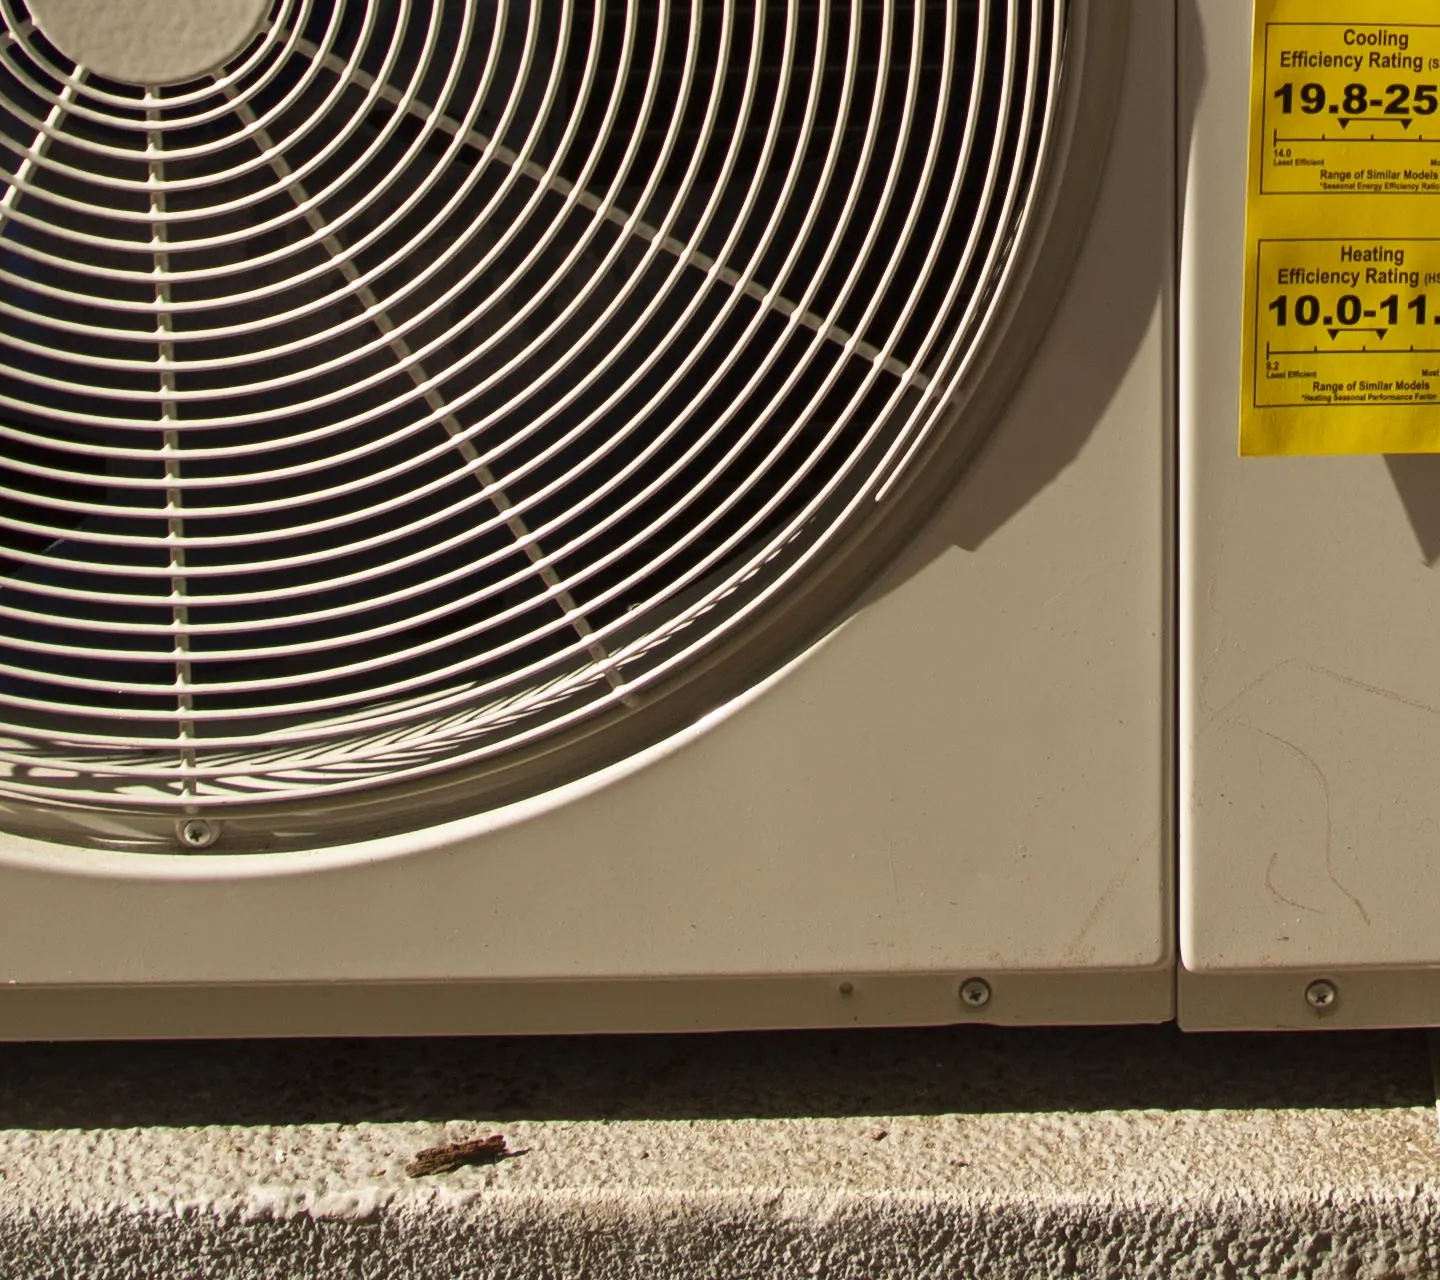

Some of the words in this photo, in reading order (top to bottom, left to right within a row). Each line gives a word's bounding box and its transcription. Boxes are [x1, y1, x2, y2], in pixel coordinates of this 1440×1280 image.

[1343, 29, 1409, 49] Cooling
[1280, 51, 1363, 71] Efficiency
[1369, 52, 1423, 72] Rating
[1273, 149, 1291, 158] 14.0
[1320, 170, 1351, 181] Range
[1354, 170, 1364, 180] of
[1366, 170, 1400, 180] Similar
[1404, 170, 1438, 180] Models
[1357, 182, 1382, 190] Energy
[1385, 182, 1419, 190] Efficiency
[1422, 182, 1440, 190] Ratio
[1341, 246, 1404, 265] Heating
[1278, 268, 1360, 288] Efficiency
[1365, 268, 1419, 287] Rating
[1266, 371, 1285, 379] Least
[1313, 381, 1343, 394] Range
[1346, 381, 1357, 391] of
[1359, 381, 1393, 391] Similar
[1395, 381, 1430, 390] Models
[1334, 393, 1366, 401] Seasonal
[1367, 393, 1412, 401] Performance
